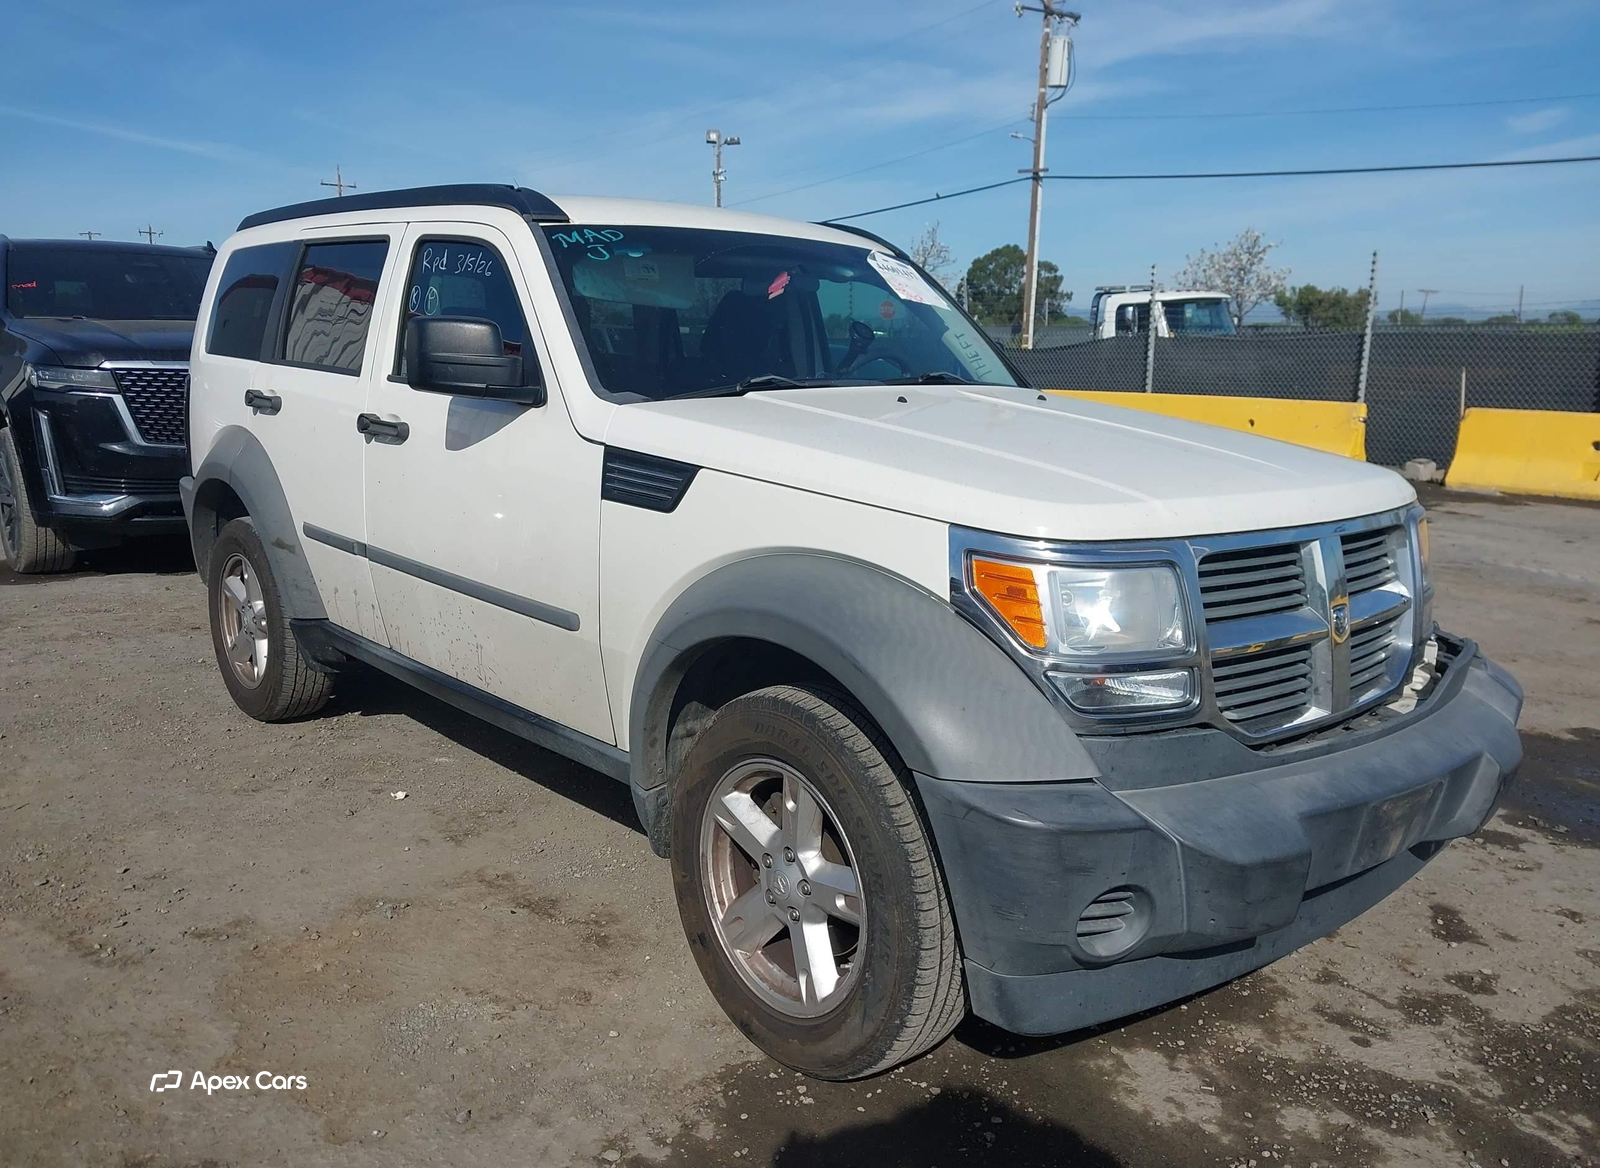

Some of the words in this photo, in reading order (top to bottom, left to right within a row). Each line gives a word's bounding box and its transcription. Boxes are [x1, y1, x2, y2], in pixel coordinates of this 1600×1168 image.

[552, 228, 625, 248] MAD
[587, 245, 611, 261] J
[454, 252, 493, 277] 3/5/26
[954, 333, 992, 379] THEFT
